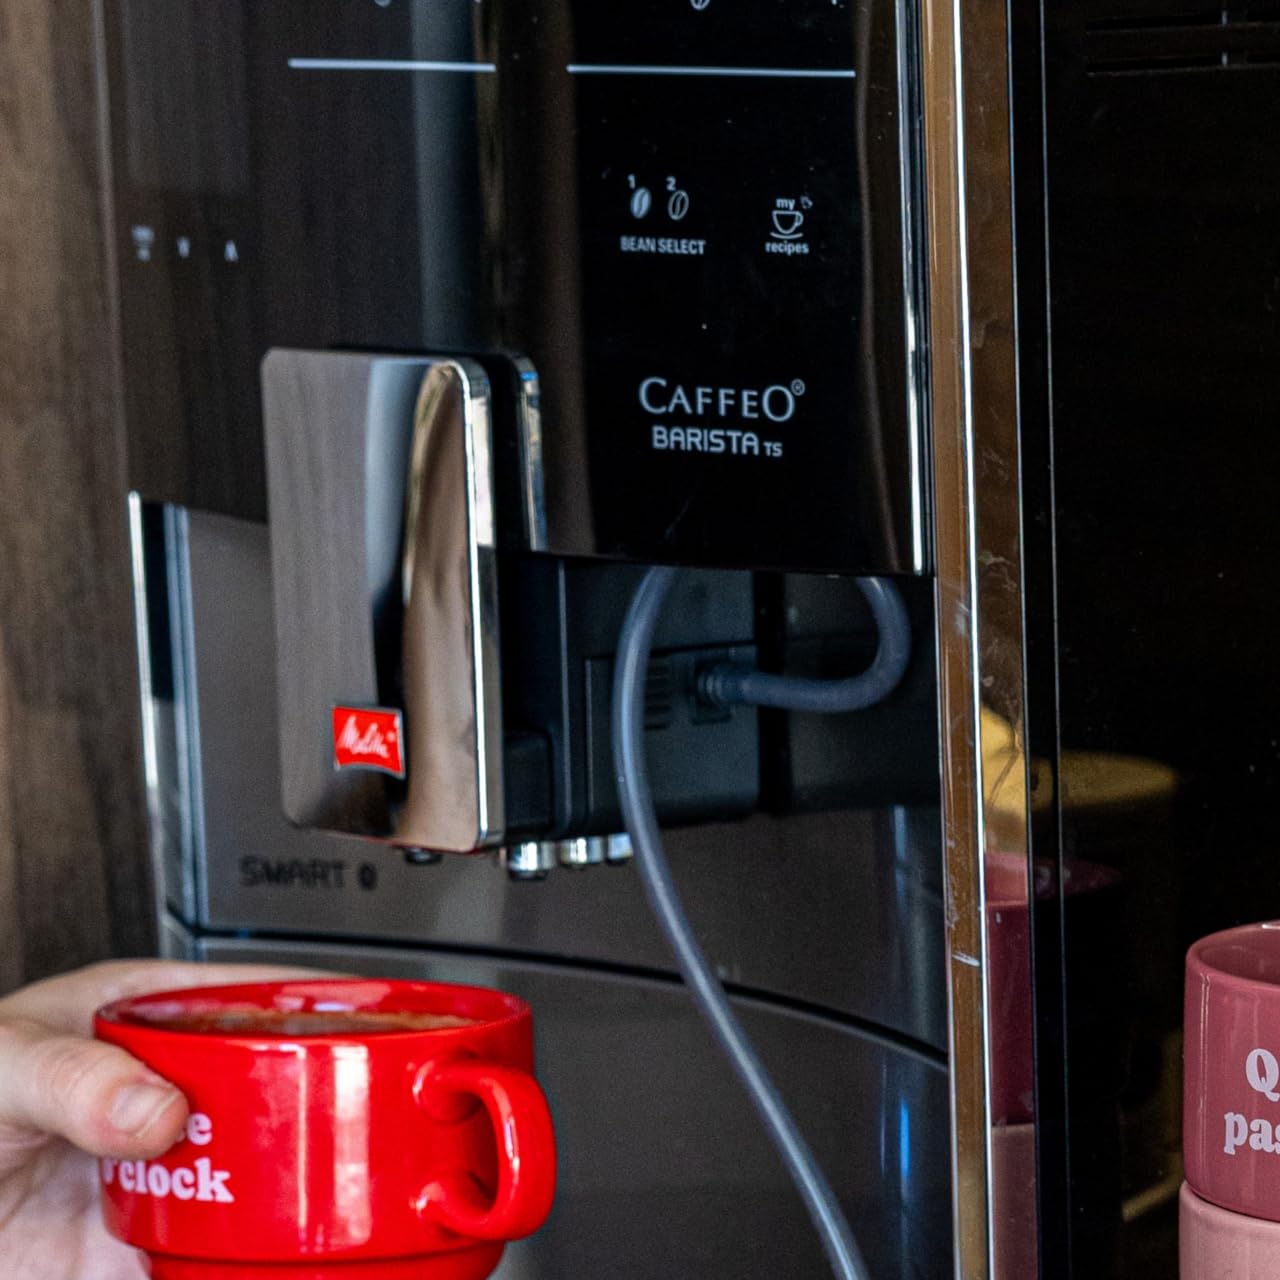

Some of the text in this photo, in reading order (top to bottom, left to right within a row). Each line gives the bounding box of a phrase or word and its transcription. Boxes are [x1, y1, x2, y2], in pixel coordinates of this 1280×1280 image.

[627, 174, 677, 191] 1 2
[776, 197, 796, 211] my
[620, 236, 706, 254] BEAN SELECT
[765, 241, 810, 256] recipes
[652, 425, 783, 457] BARISTA TS
[239, 855, 344, 888] SMART
